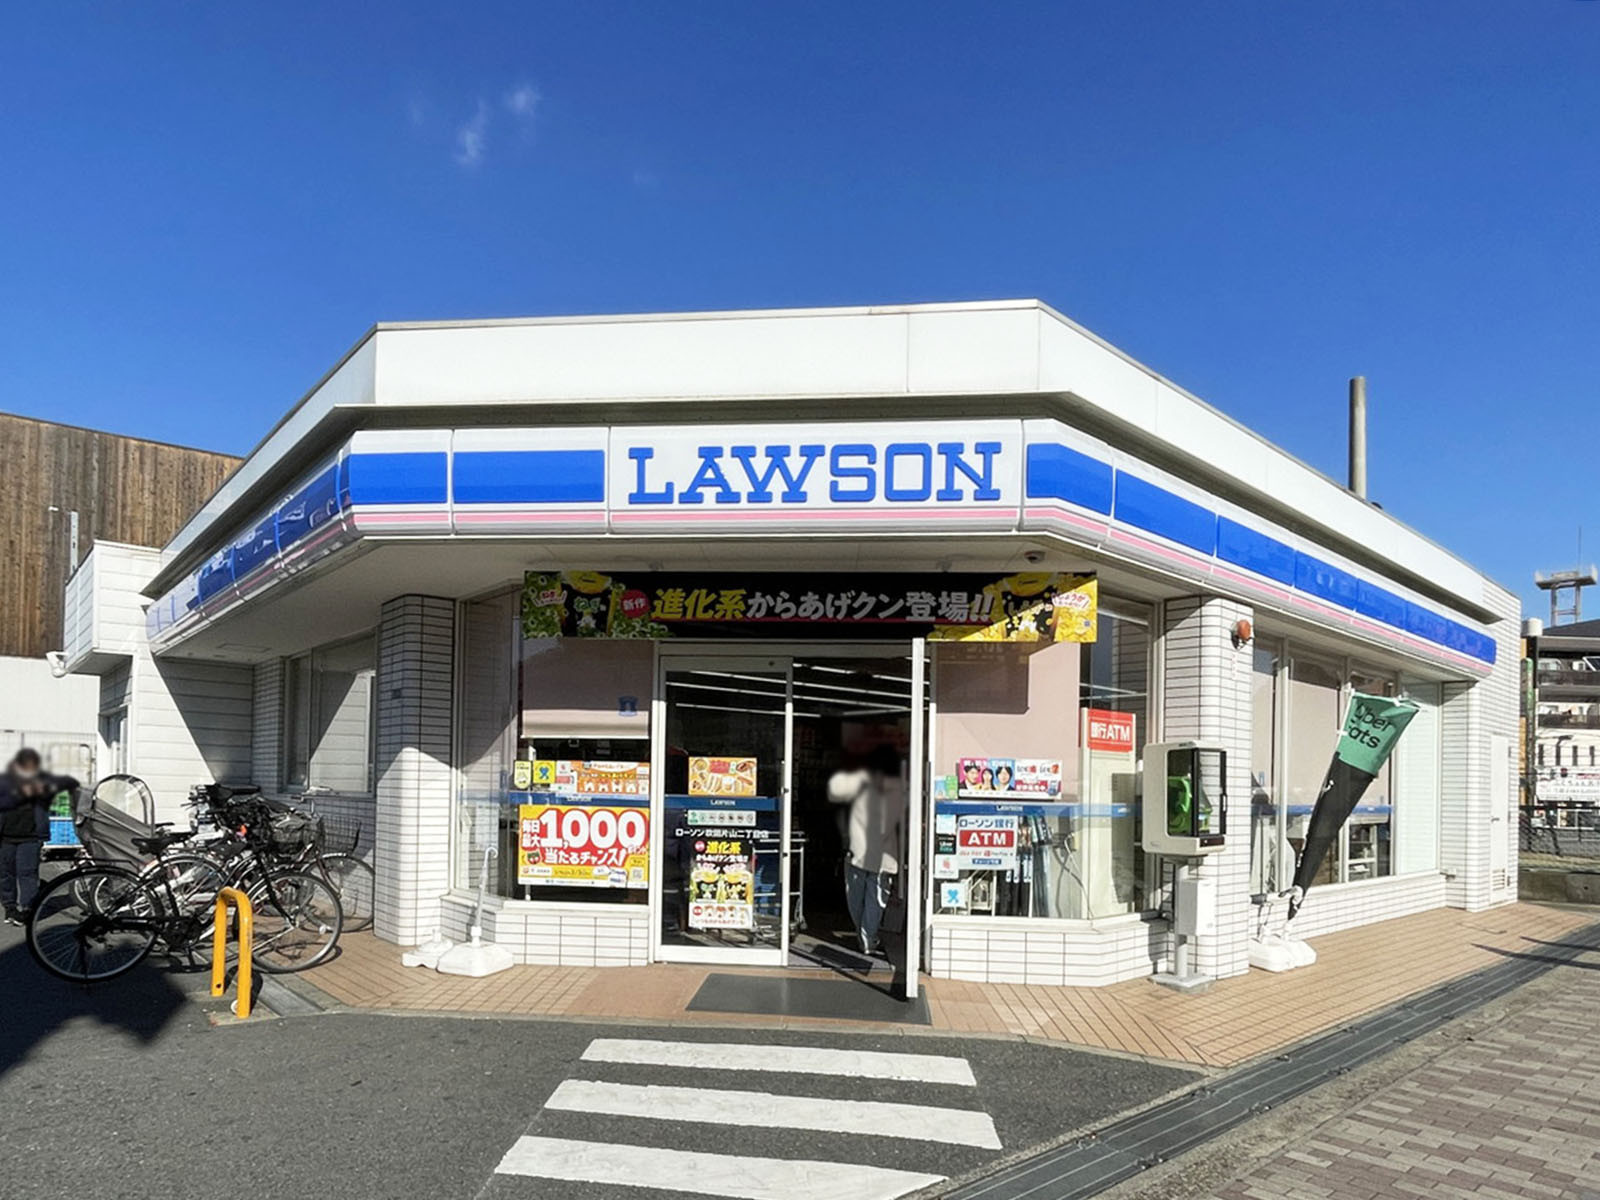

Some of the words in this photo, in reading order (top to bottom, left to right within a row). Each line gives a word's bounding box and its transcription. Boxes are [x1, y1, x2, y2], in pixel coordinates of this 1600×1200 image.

[628, 442, 1001, 504] LAWSON
[651, 588, 995, 622] 進化系からあげクン登場!!
[959, 819, 1014, 828] ローソン銀行
[968, 832, 1007, 845] ATM
[544, 847, 626, 866] 当たるチャンス!
